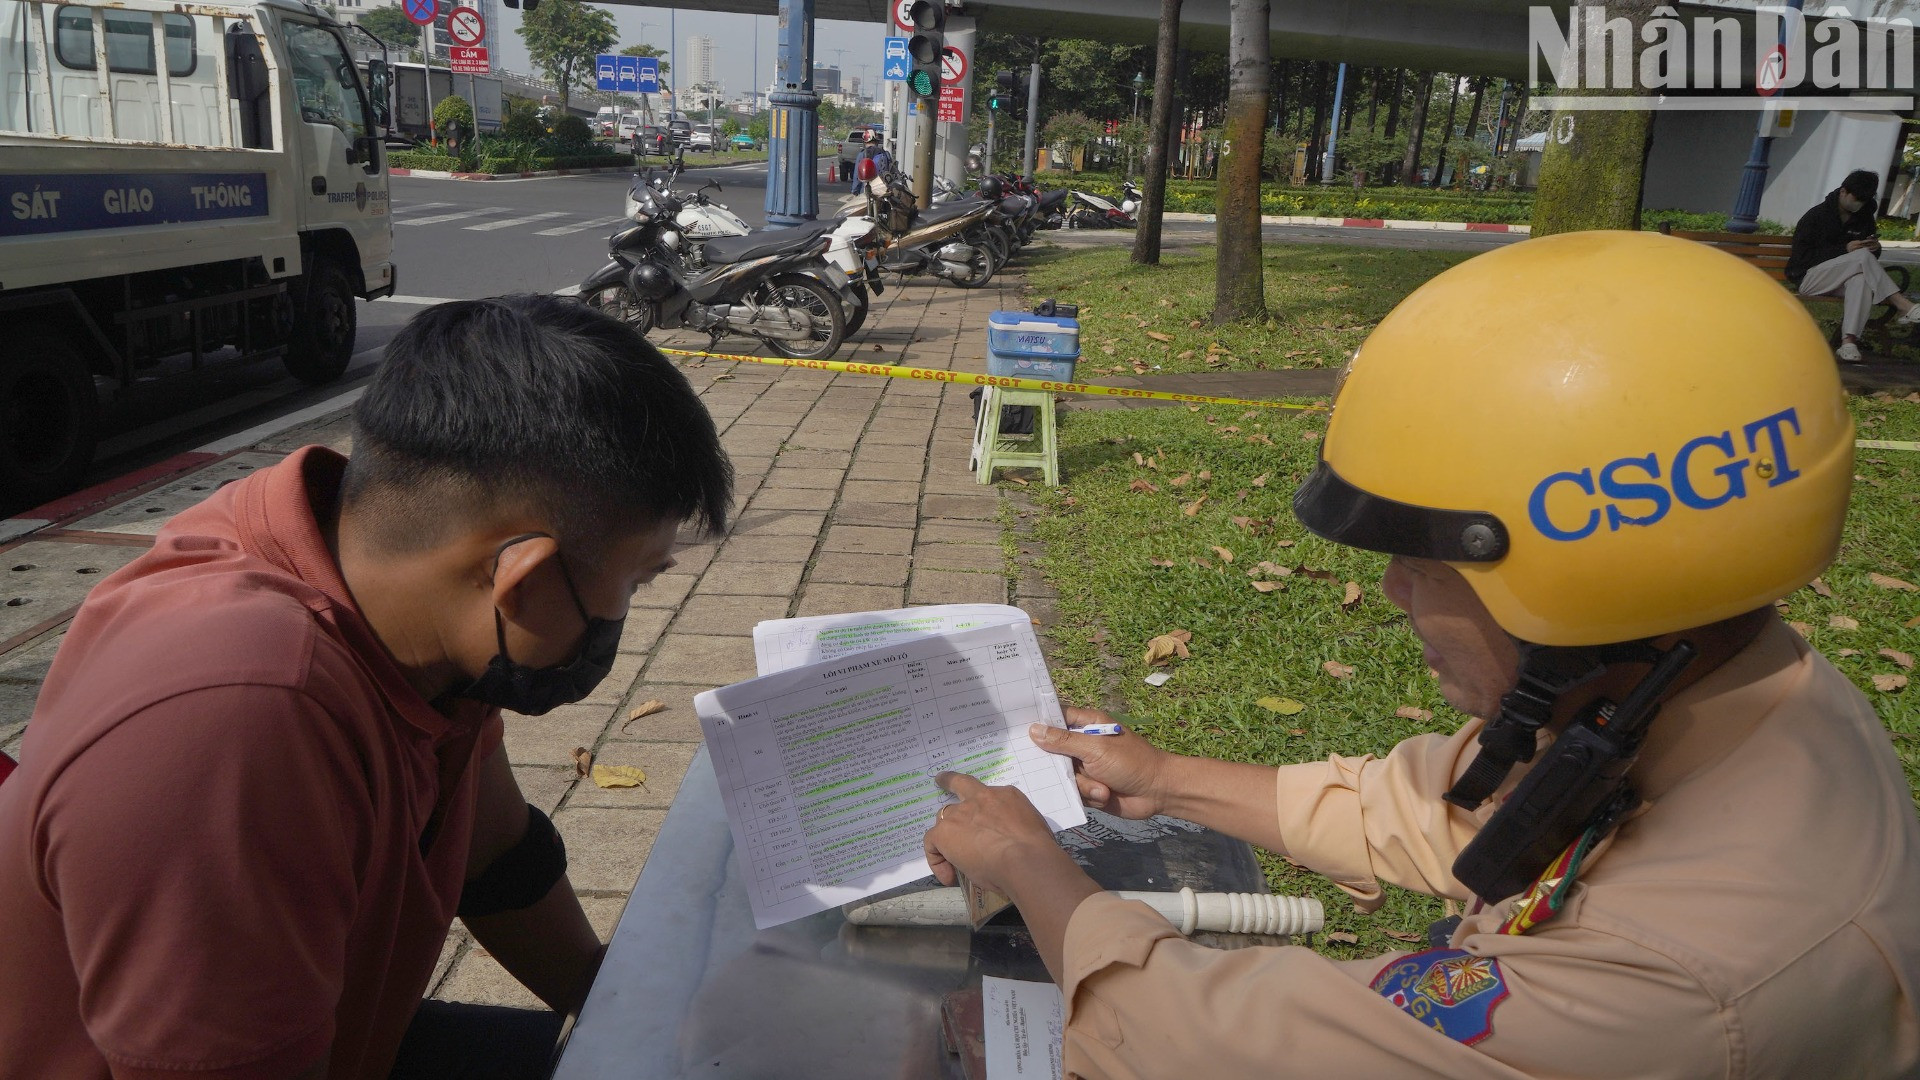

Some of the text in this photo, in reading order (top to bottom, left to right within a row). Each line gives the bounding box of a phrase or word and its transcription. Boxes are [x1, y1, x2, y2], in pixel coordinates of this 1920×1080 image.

[460, 47, 478, 58] CẤM
[11, 182, 251, 220] SÁT GIAO THÔNG
[327, 191, 356, 203] TRAFFIC
[845, 363, 892, 376] CSGT
[911, 369, 958, 383] CSGT
[974, 375, 1022, 388] CSGT
[1041, 381, 1088, 392] CSGT
[1107, 388, 1155, 398] CSGT
[1528, 407, 1801, 541] CSGT
[847, 662, 870, 672] PHẠM
[883, 655, 895, 663] MÔ
[897, 651, 908, 659] TÔ
